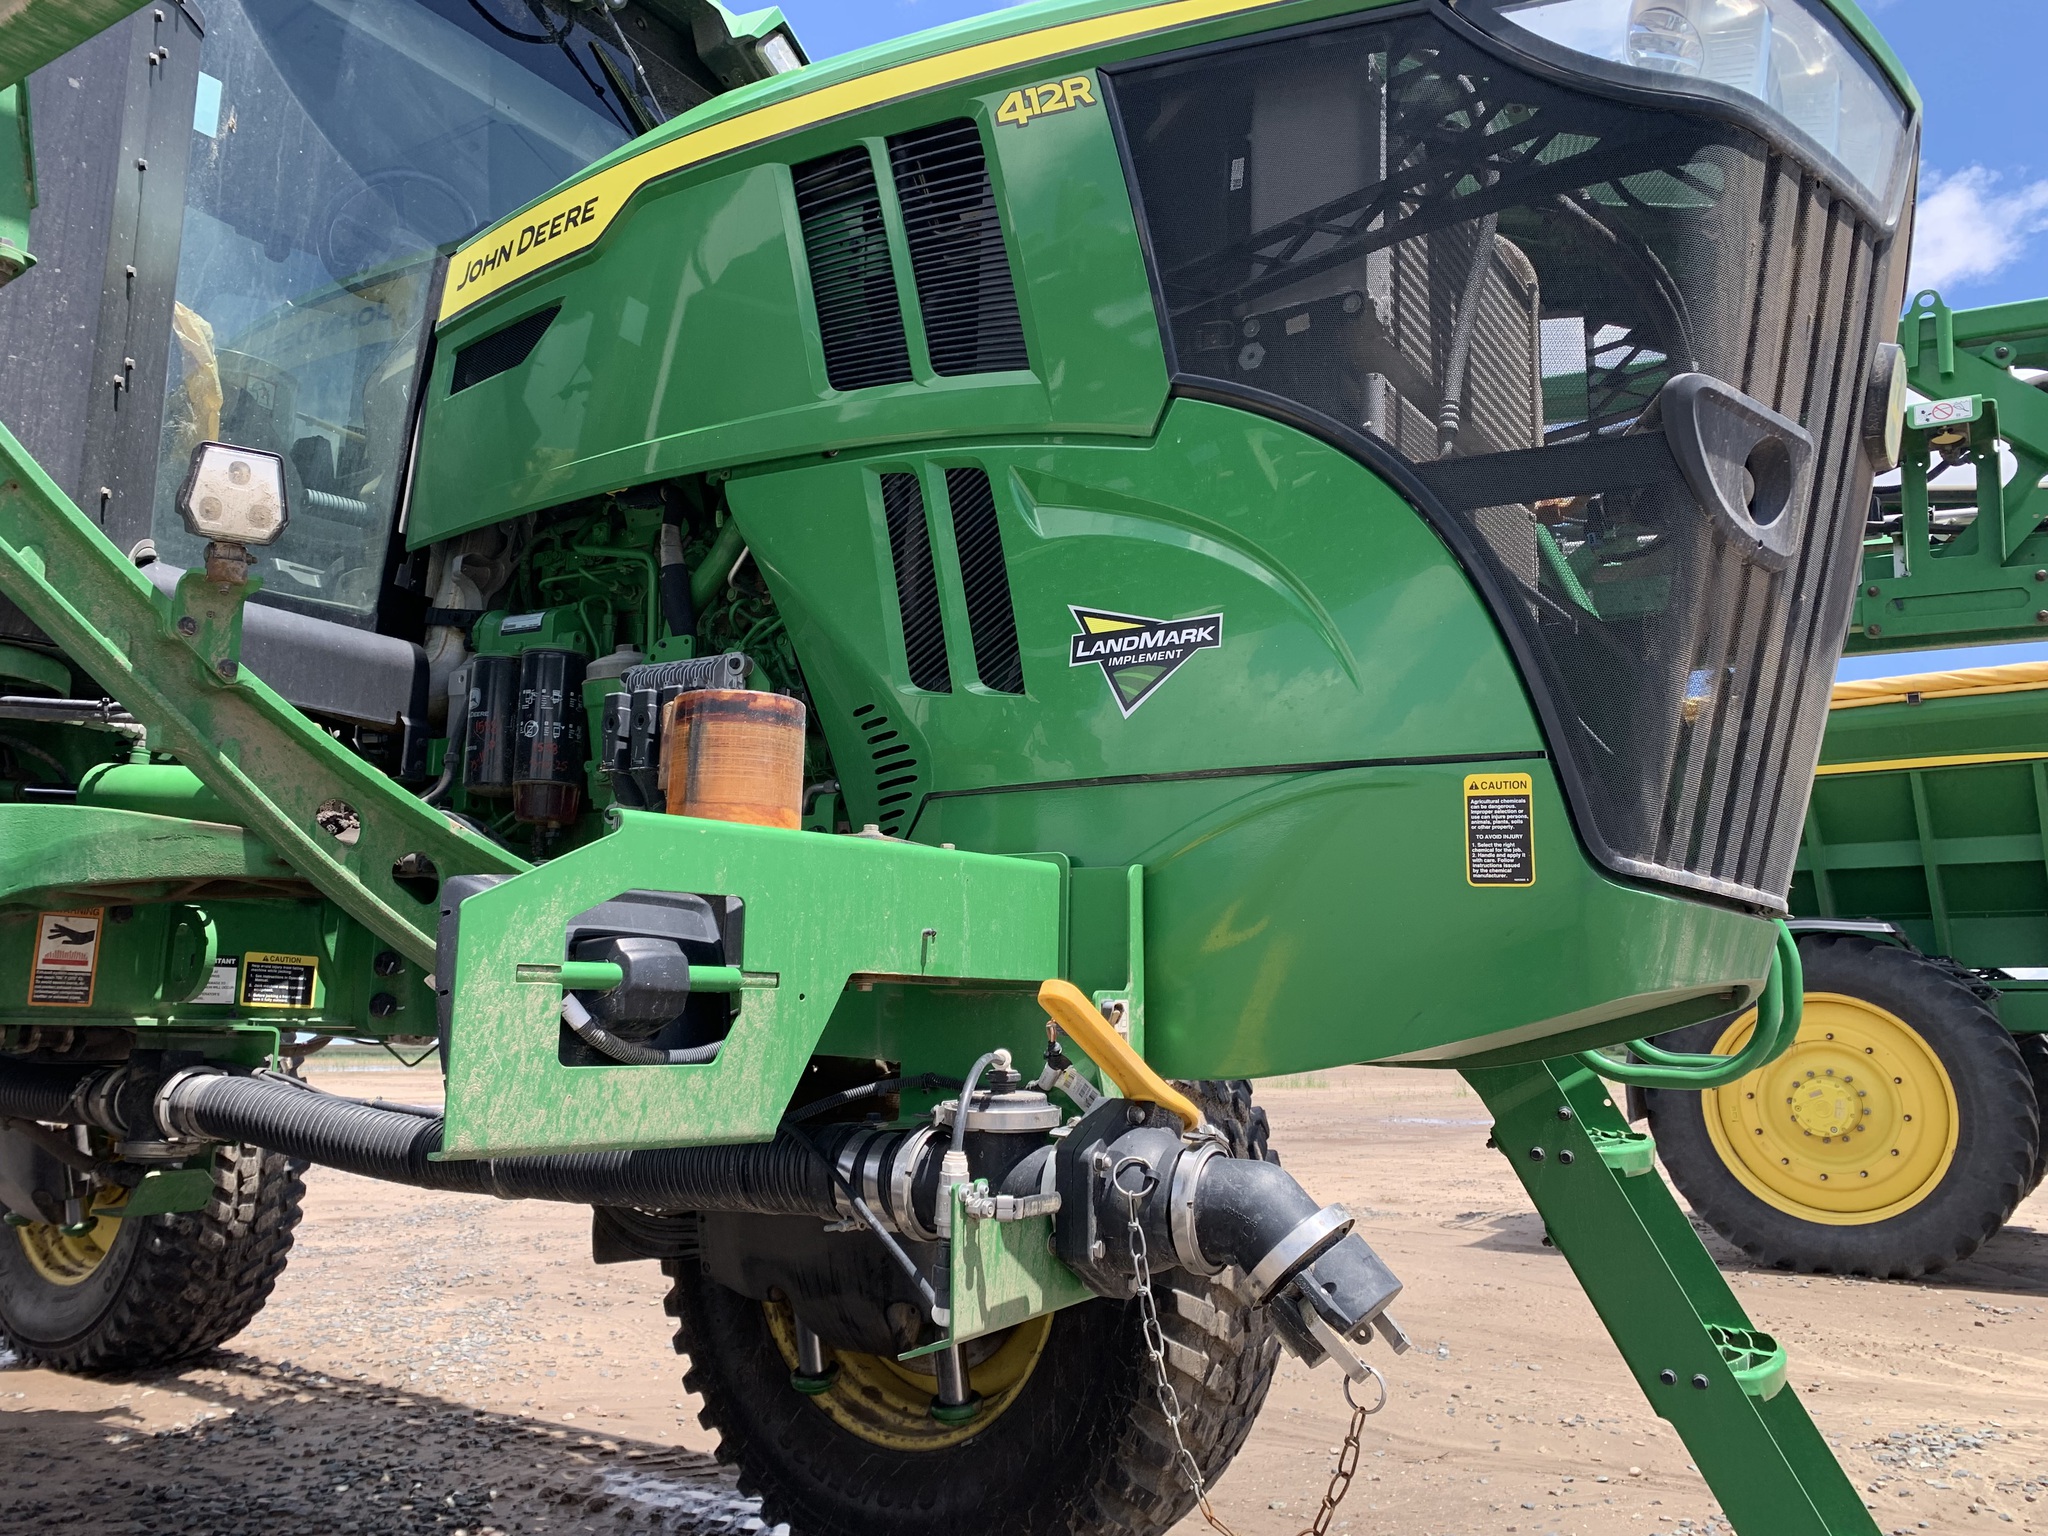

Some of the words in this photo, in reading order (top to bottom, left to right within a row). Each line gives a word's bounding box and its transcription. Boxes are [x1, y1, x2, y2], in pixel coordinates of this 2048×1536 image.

[995, 76, 1097, 129] 412R
[457, 240, 514, 291] JOHN
[516, 196, 599, 257] DEERE
[1076, 625, 1216, 658] LANDMARK
[1108, 649, 1184, 667] IMPLEMENT
[1481, 781, 1527, 790] CAUTION
